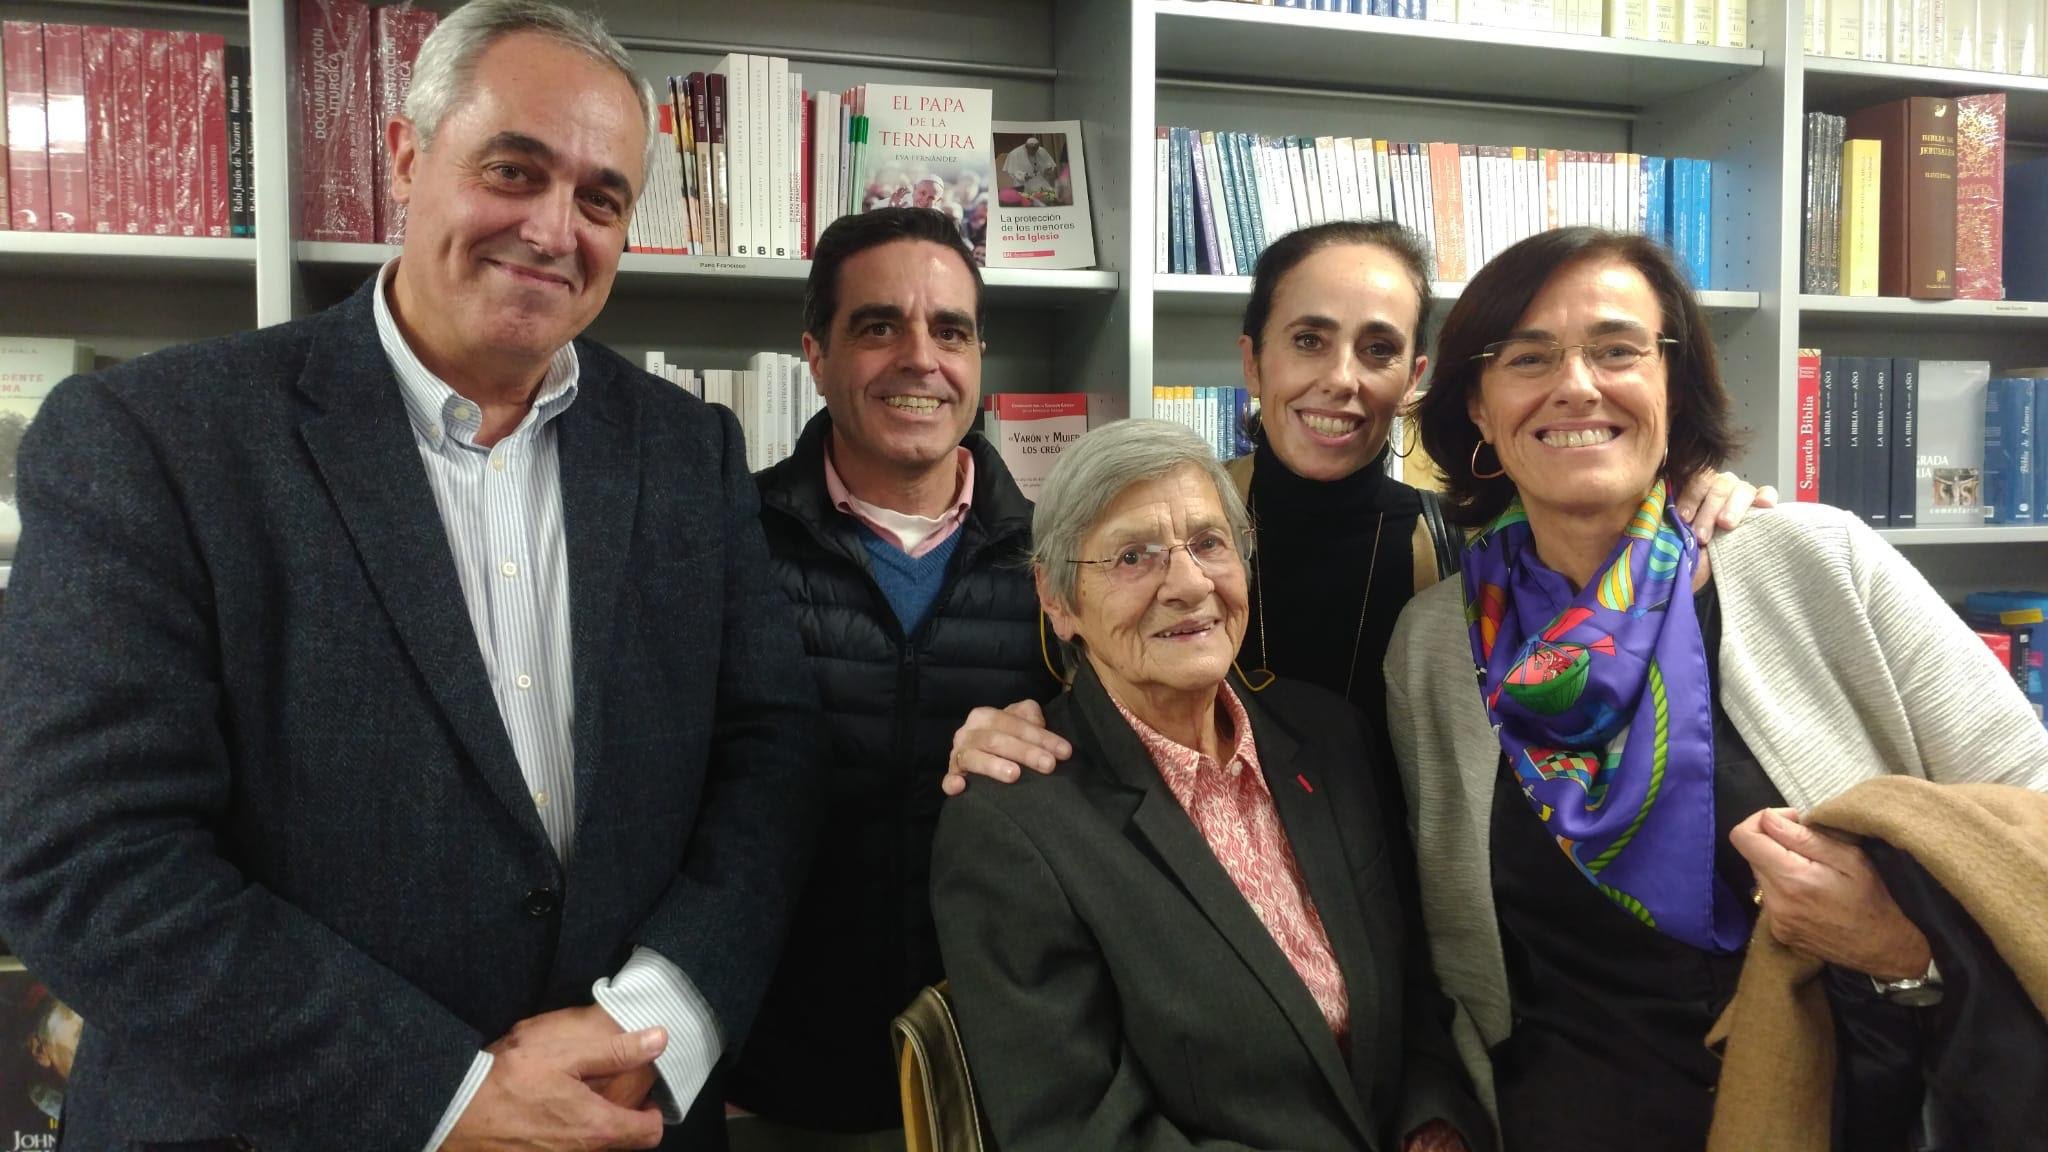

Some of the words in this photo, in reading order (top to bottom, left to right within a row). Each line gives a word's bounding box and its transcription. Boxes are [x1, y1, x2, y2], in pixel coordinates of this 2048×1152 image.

[312, 28, 326, 138] DOCUMENTACIÓN
[893, 96, 912, 110] EL
[920, 96, 964, 112] PAPA
[910, 117, 927, 127] DE
[931, 117, 946, 127] LA
[231, 122, 241, 154] Nazaret
[879, 131, 975, 149] TERNURA
[232, 158, 241, 167] de
[232, 170, 245, 192] Jesús
[233, 192, 243, 212] Rabí
[1000, 214, 1012, 223] La
[1014, 213, 1061, 224] protección
[1033, 222, 1075, 231] menores
[1016, 233, 1025, 241] la
[1028, 232, 1059, 242] Iglesia
[1799, 395, 1814, 434] Biblia
[1824, 437, 1830, 447] LA
[1851, 437, 1858, 447] LA
[1877, 437, 1884, 447] LA
[1905, 437, 1912, 447] LA
[1023, 446, 1037, 454] LOS
[1801, 439, 1815, 489] Sagrada
[1917, 455, 1949, 465] RADA
[1916, 468, 1932, 478] LIA
